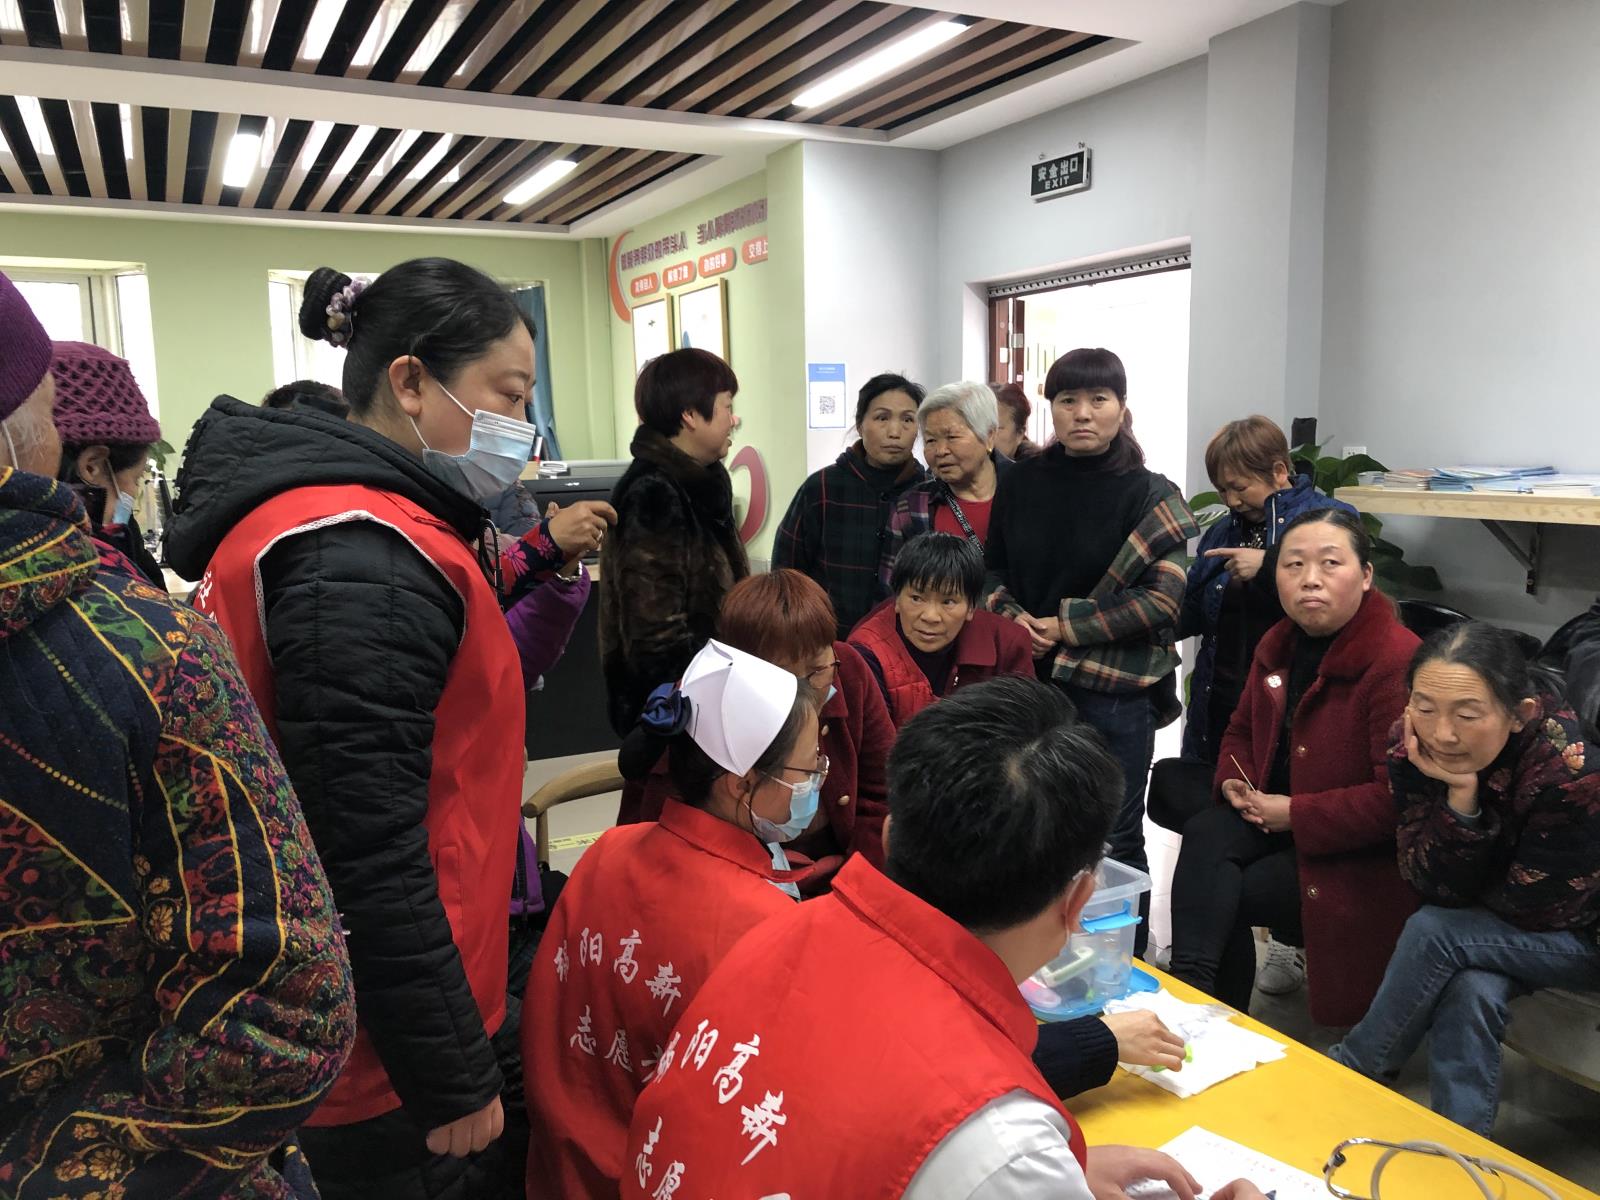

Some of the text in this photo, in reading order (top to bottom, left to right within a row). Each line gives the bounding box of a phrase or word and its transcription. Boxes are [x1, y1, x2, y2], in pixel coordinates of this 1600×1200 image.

[1038, 157, 1079, 182] 安全出口
[1045, 176, 1070, 190] EXIT
